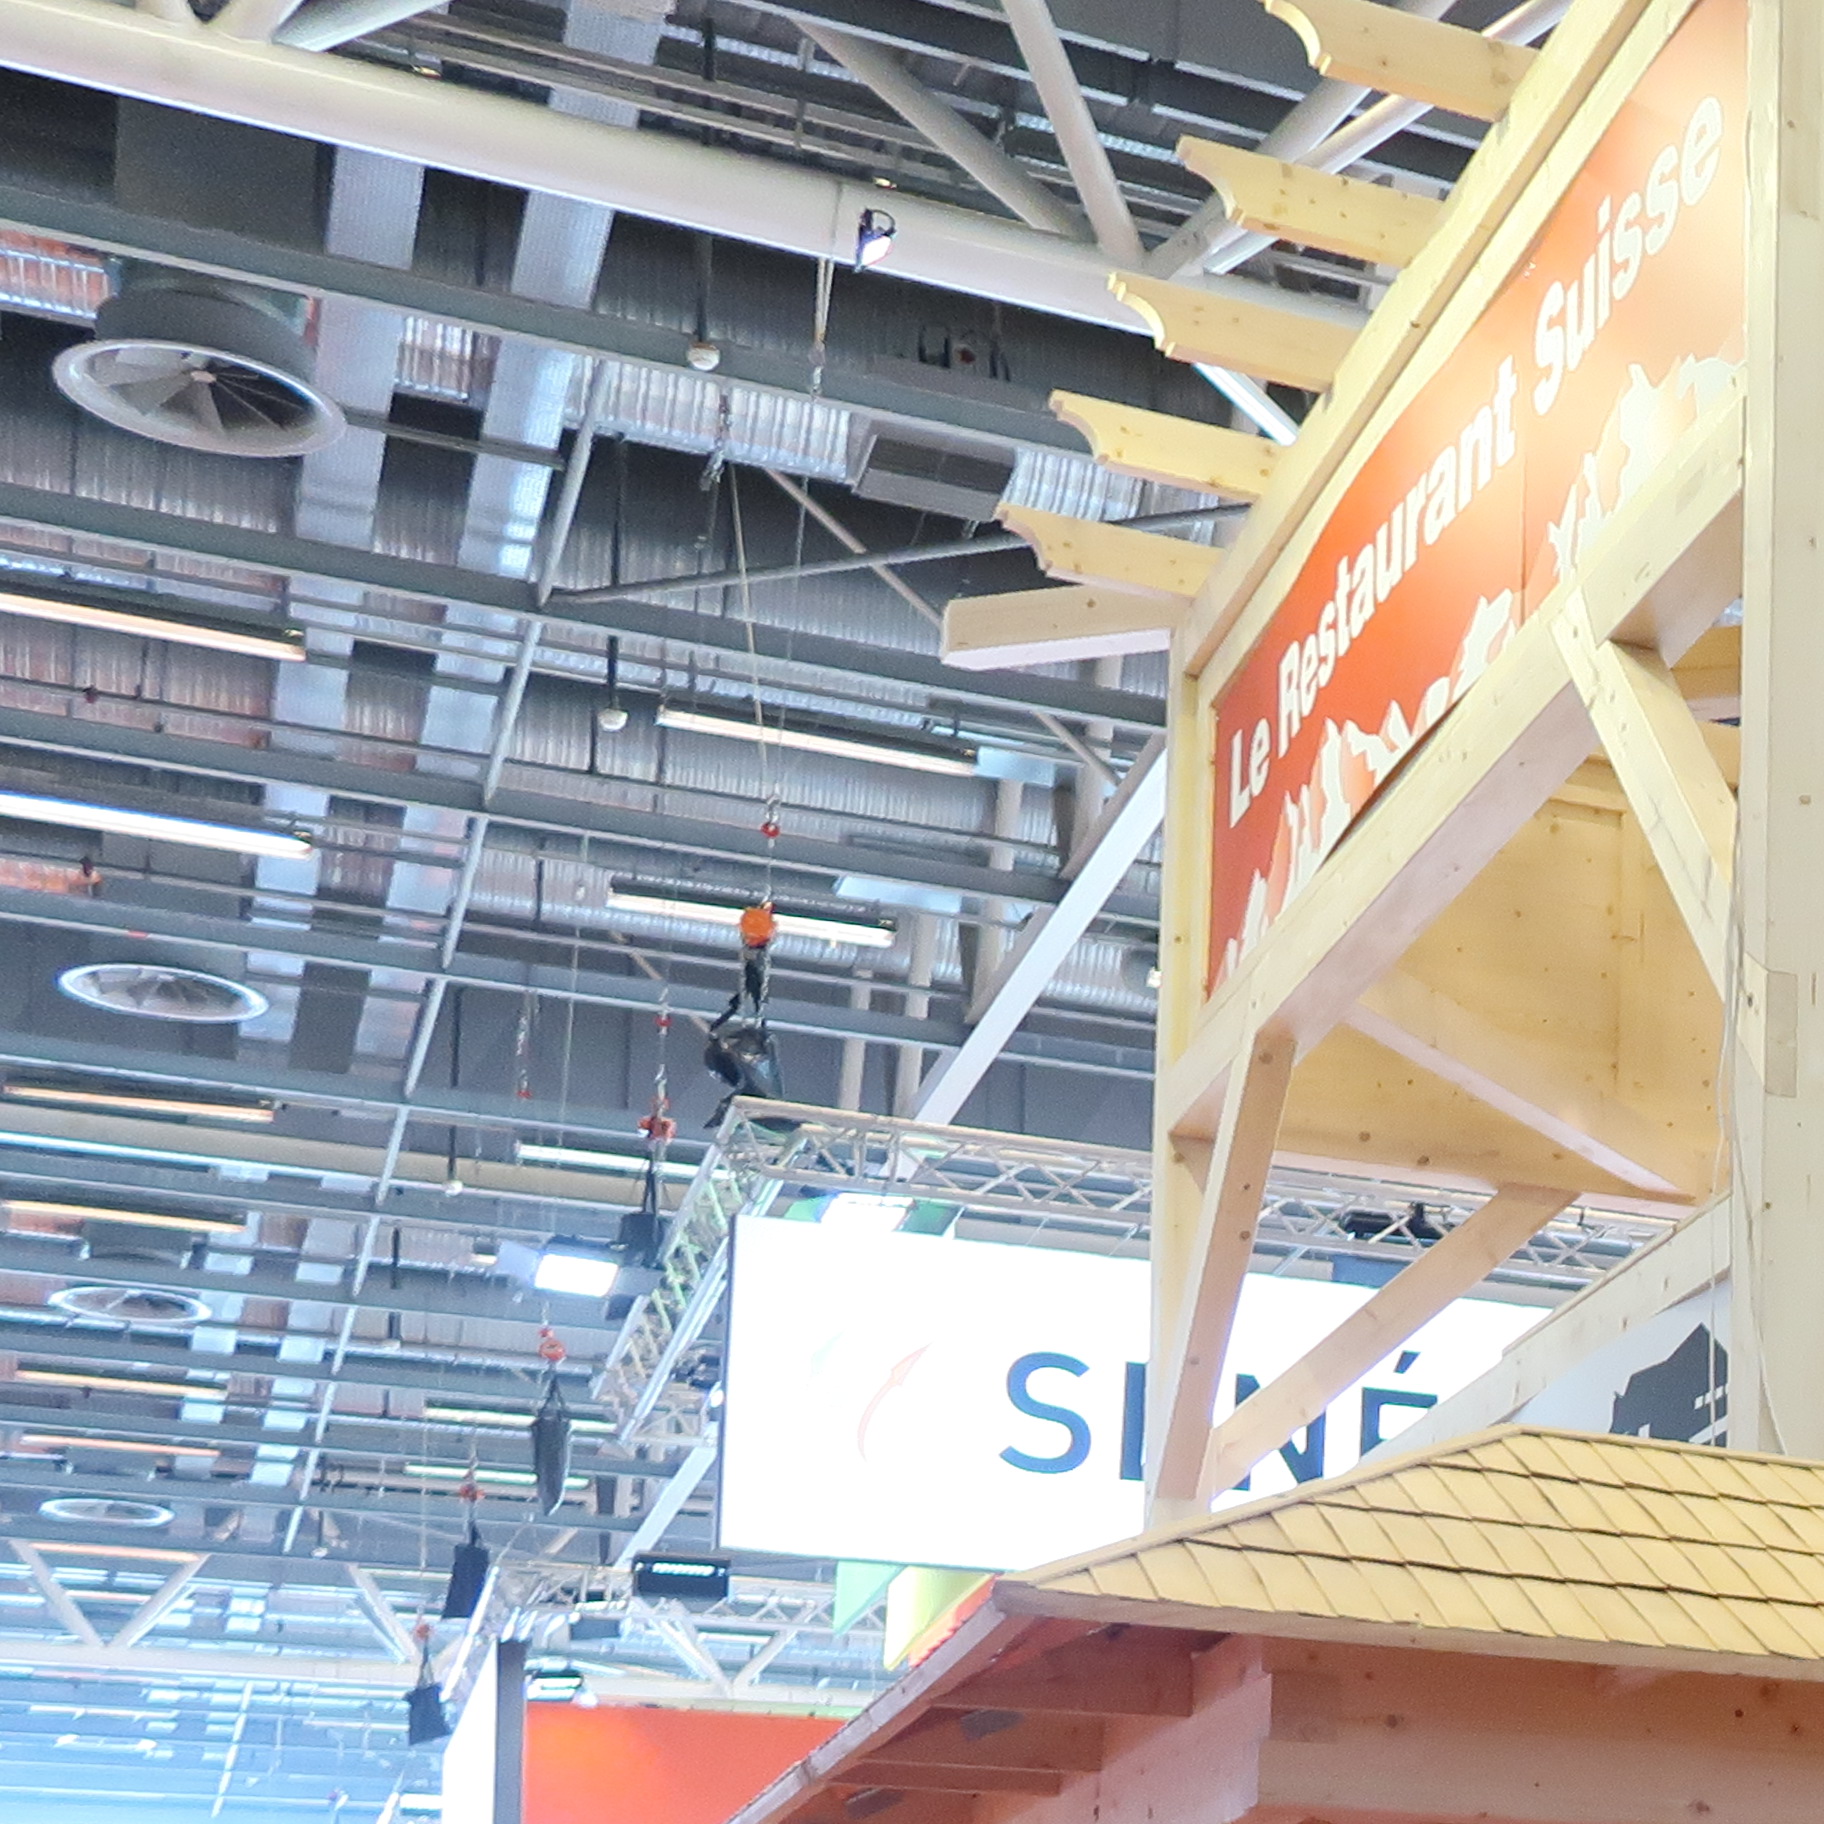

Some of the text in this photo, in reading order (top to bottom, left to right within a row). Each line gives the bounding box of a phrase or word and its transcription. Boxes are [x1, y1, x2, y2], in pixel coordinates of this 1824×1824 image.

[1228, 95, 1724, 829] Le Restaurant Suisse
